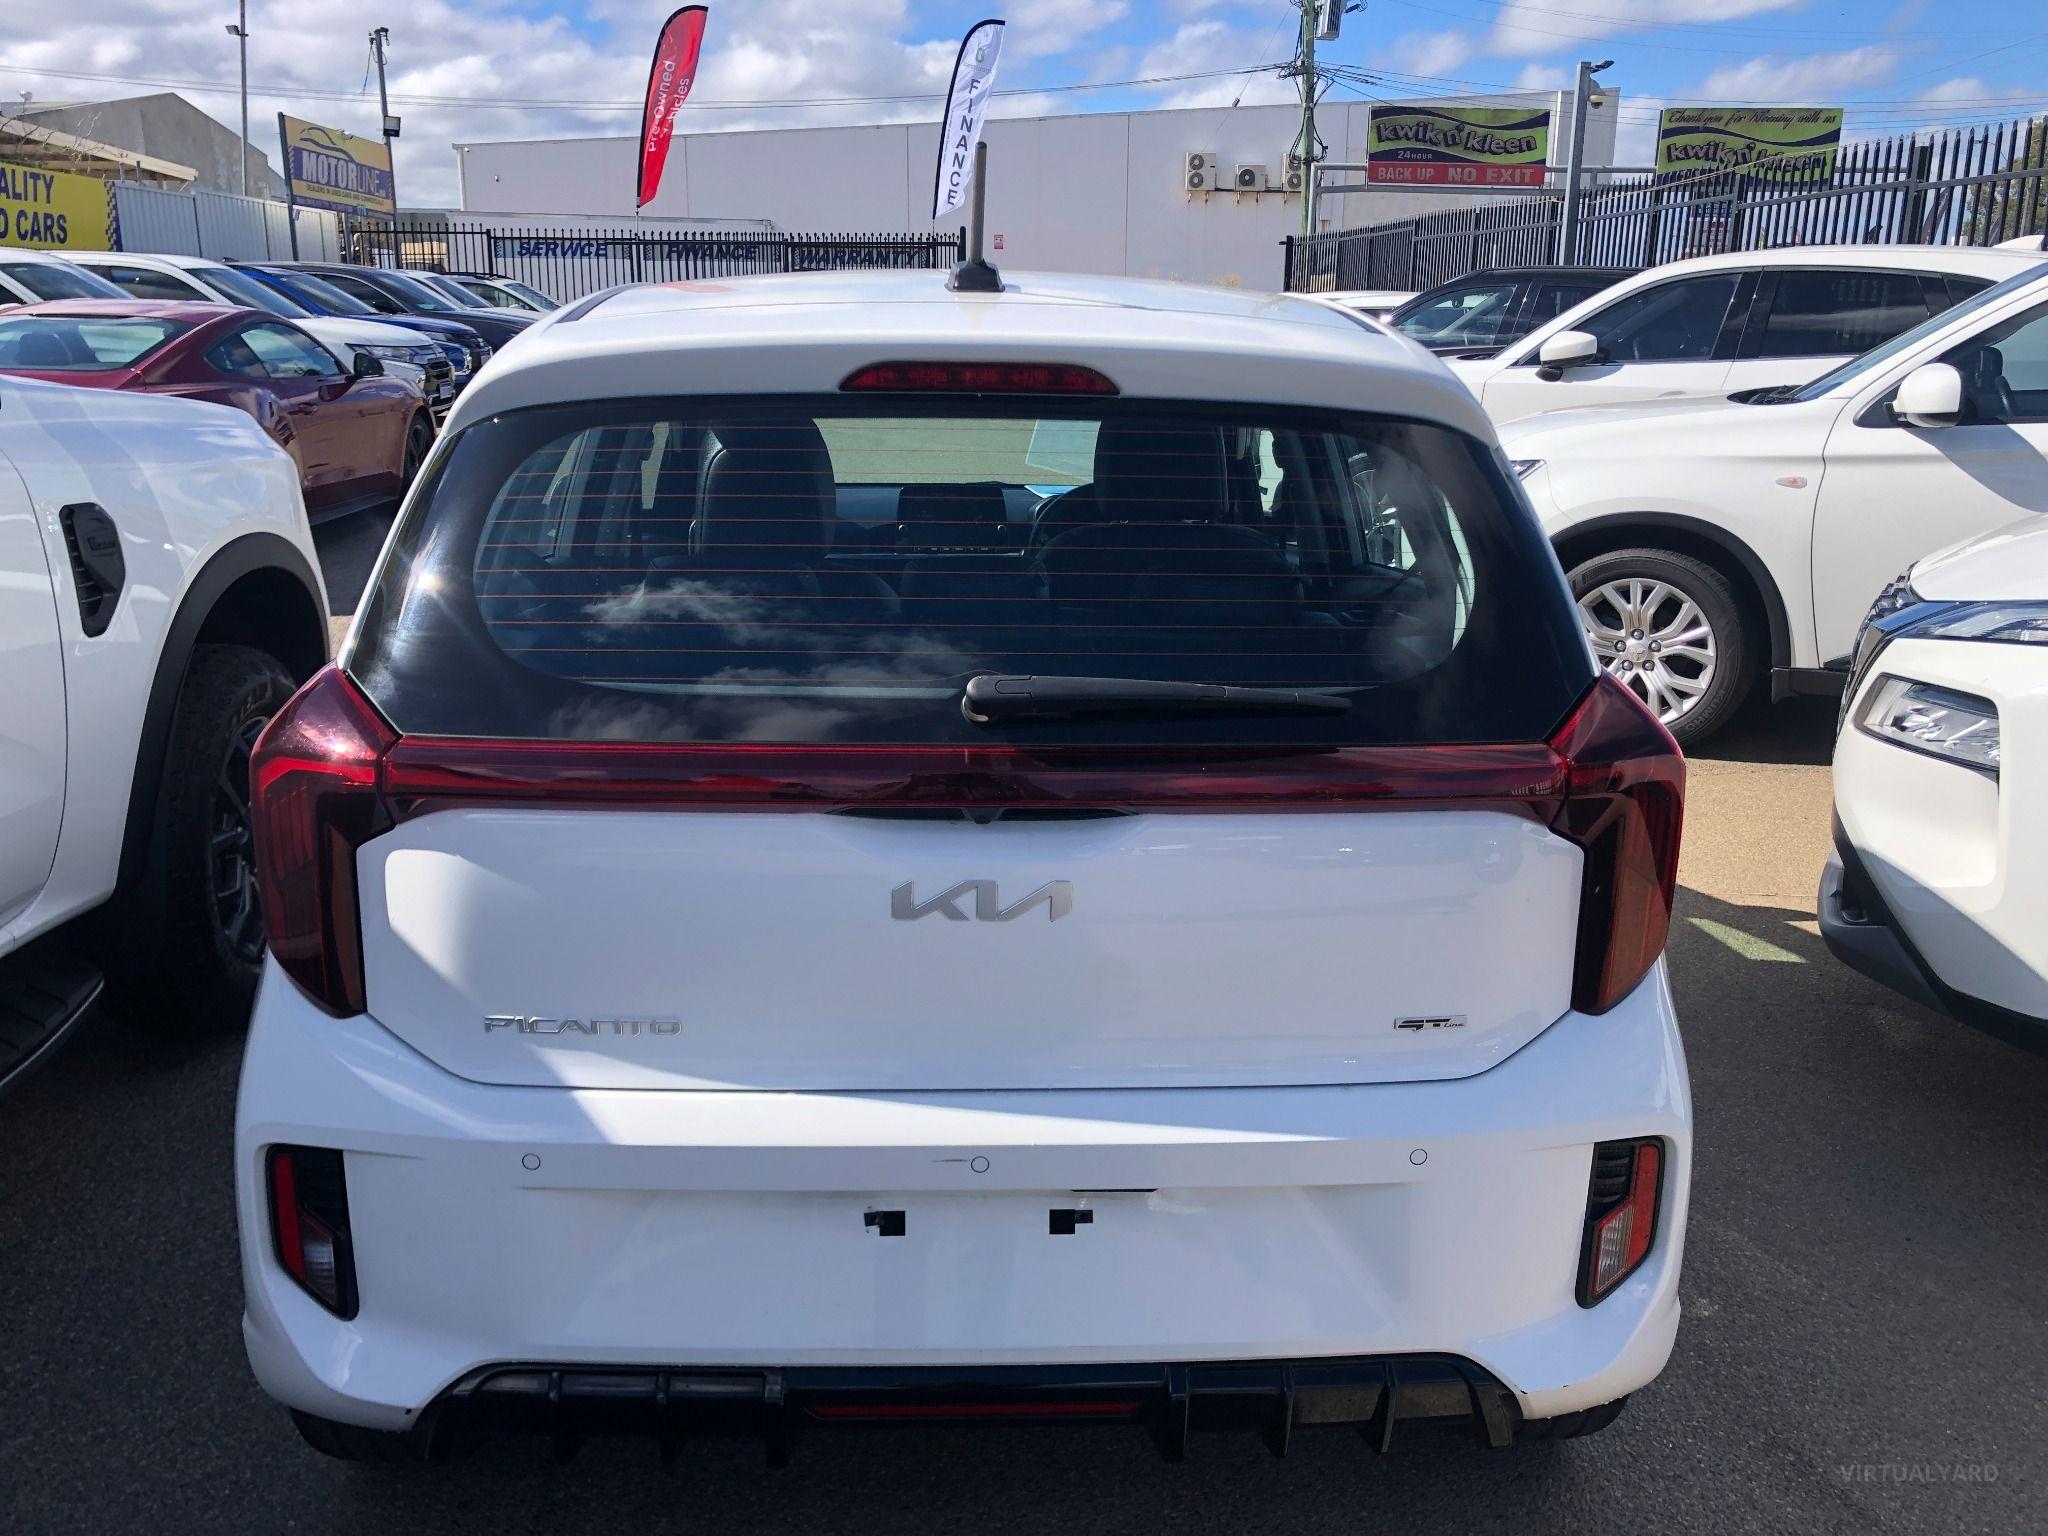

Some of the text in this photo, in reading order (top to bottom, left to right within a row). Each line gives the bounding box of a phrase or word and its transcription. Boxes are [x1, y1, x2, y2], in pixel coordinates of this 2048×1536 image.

[648, 60, 676, 152] Pre-Owned
[660, 78, 690, 138] Vhicles
[947, 78, 981, 206] FINANCE
[1376, 121, 1442, 147] kwik
[1464, 131, 1538, 155] kleen
[302, 150, 381, 196] MOTORLINE
[1378, 167, 1535, 184] BACK UP NO EXIT
[16, 209, 68, 244] CARS
[517, 241, 608, 257] SERVICE
[800, 247, 918, 266] WARRANTY
[891, 879, 1073, 922] KIA
[484, 1015, 682, 1037] PICANTO
